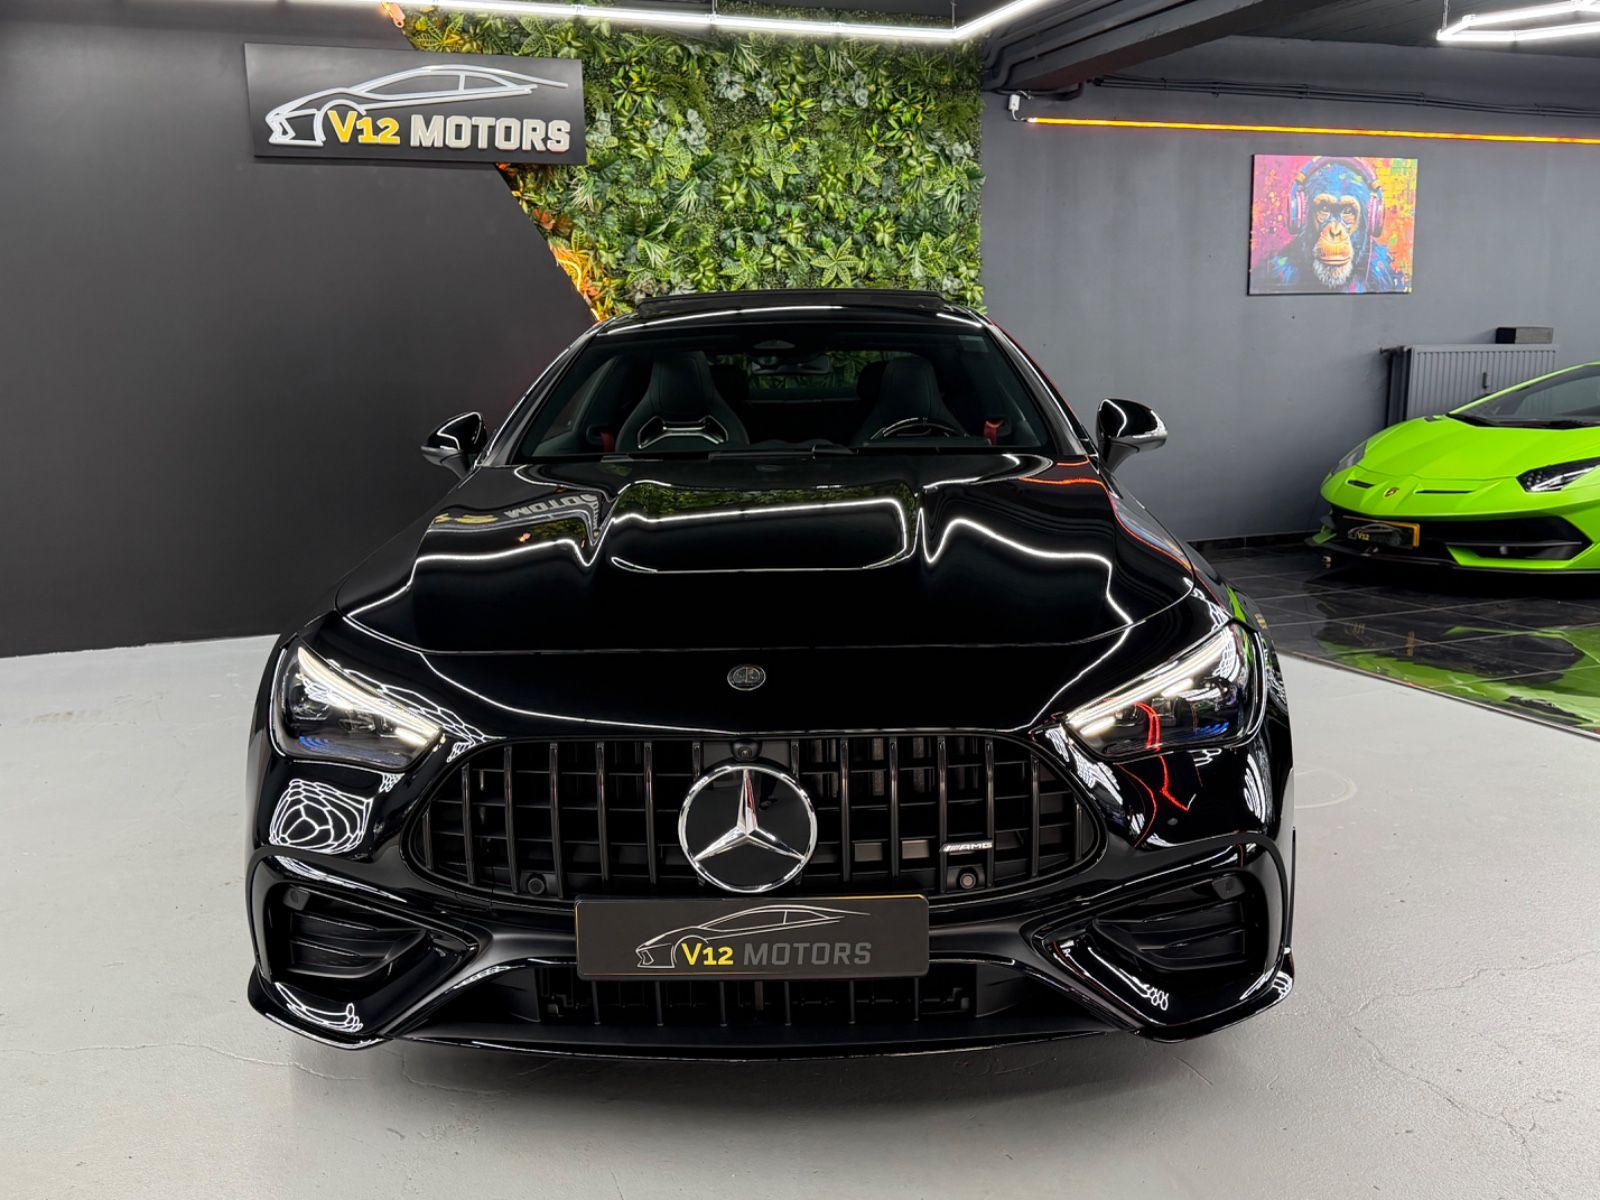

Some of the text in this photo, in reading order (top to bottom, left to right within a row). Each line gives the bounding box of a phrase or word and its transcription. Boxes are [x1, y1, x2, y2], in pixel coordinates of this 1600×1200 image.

[328, 110, 571, 153] V12 MOTORS
[958, 842, 993, 851] AMG
[681, 942, 872, 966] V12 MOTORS
